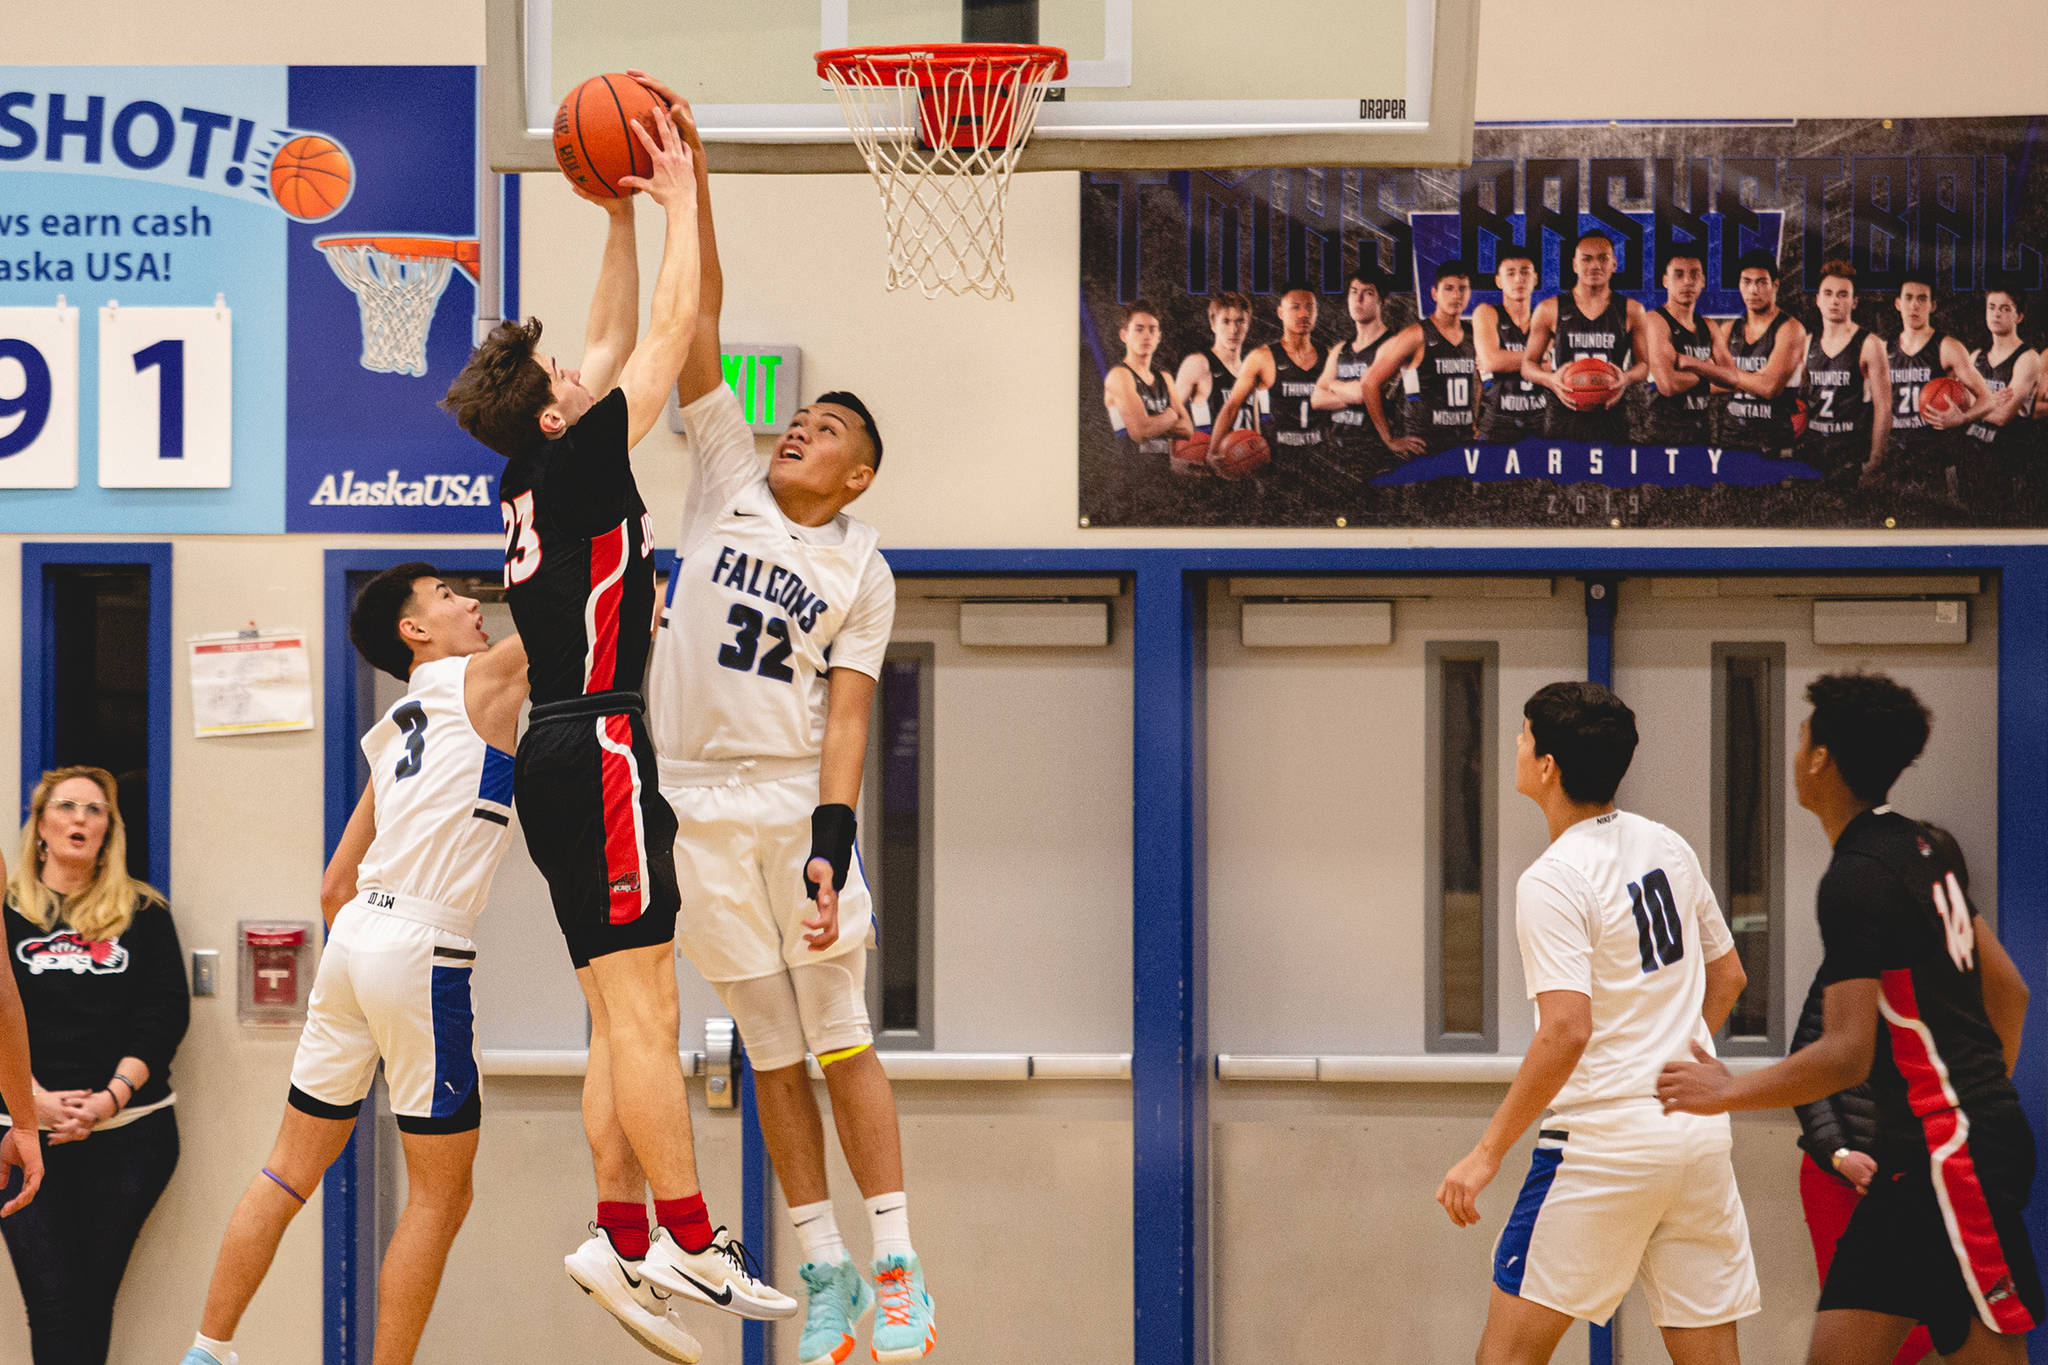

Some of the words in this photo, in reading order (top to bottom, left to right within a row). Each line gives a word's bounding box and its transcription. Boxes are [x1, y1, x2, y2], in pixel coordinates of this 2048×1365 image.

[0, 92, 255, 187] SHOT!
[41, 214, 121, 237] earn
[132, 205, 212, 237] cash
[87, 252, 171, 282] USA!
[1568, 332, 1616, 349] THUNDER
[132, 339, 184, 460] 1
[720, 353, 782, 425] IT
[1447, 377, 1469, 407] 10
[1810, 370, 1851, 386] THUNDER
[1819, 390, 1834, 418] 2
[1464, 448, 1722, 475] VARSITY
[1547, 494, 1639, 514] 2019
[501, 489, 543, 590] 23
[711, 546, 829, 634] FALCONS
[718, 603, 794, 684] 32
[392, 700, 428, 783] 3
[1626, 868, 1684, 974] 10
